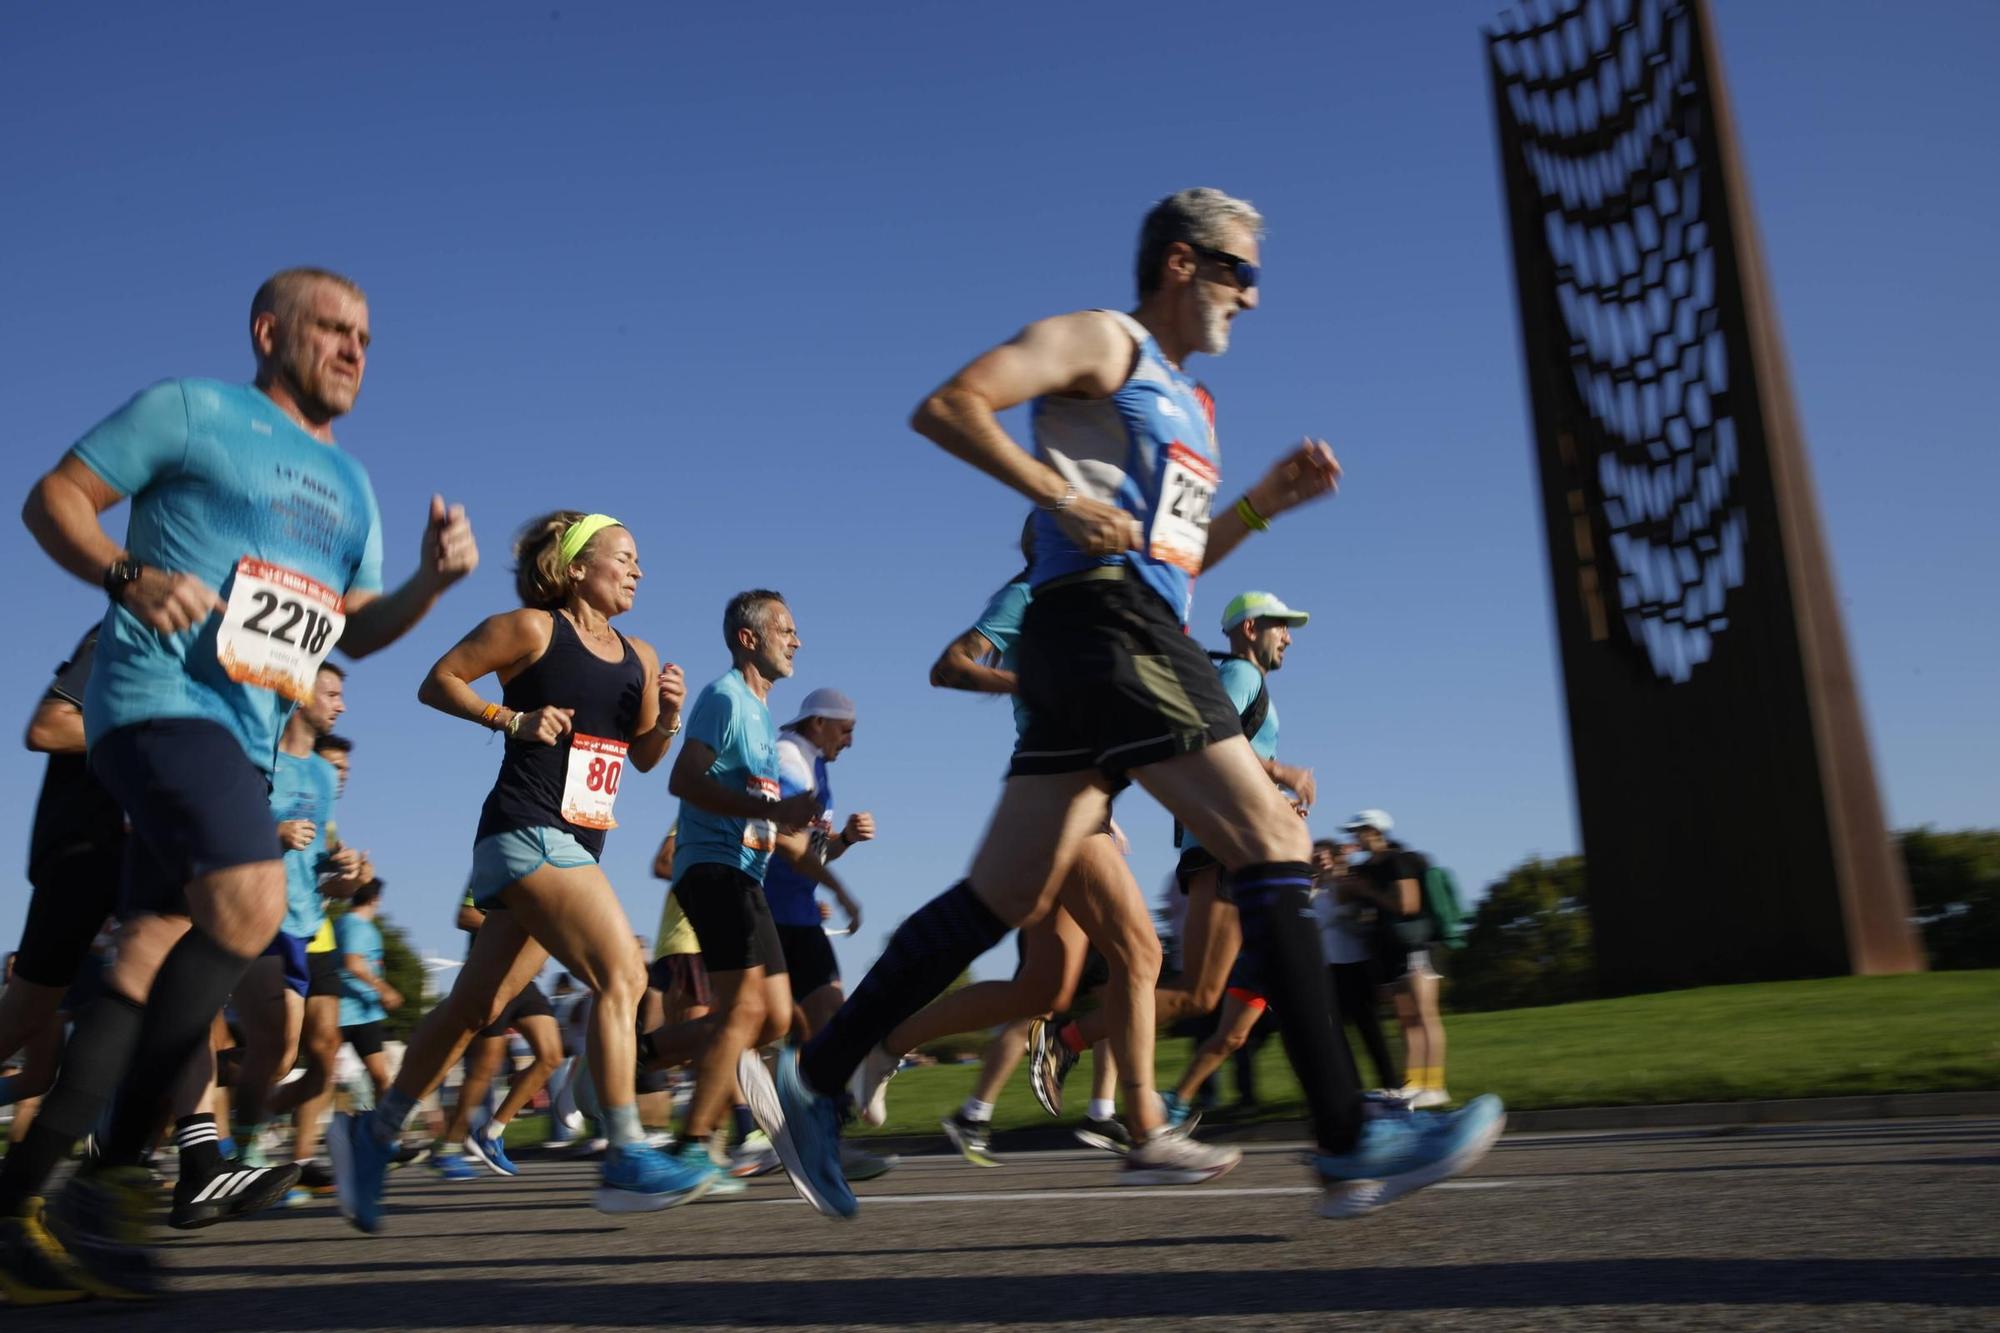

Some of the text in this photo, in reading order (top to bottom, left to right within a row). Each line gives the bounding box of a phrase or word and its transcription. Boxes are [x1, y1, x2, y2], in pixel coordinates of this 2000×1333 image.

[242, 591, 333, 655] 2218
[601, 743, 619, 754] MBA
[586, 757, 622, 795] 80
